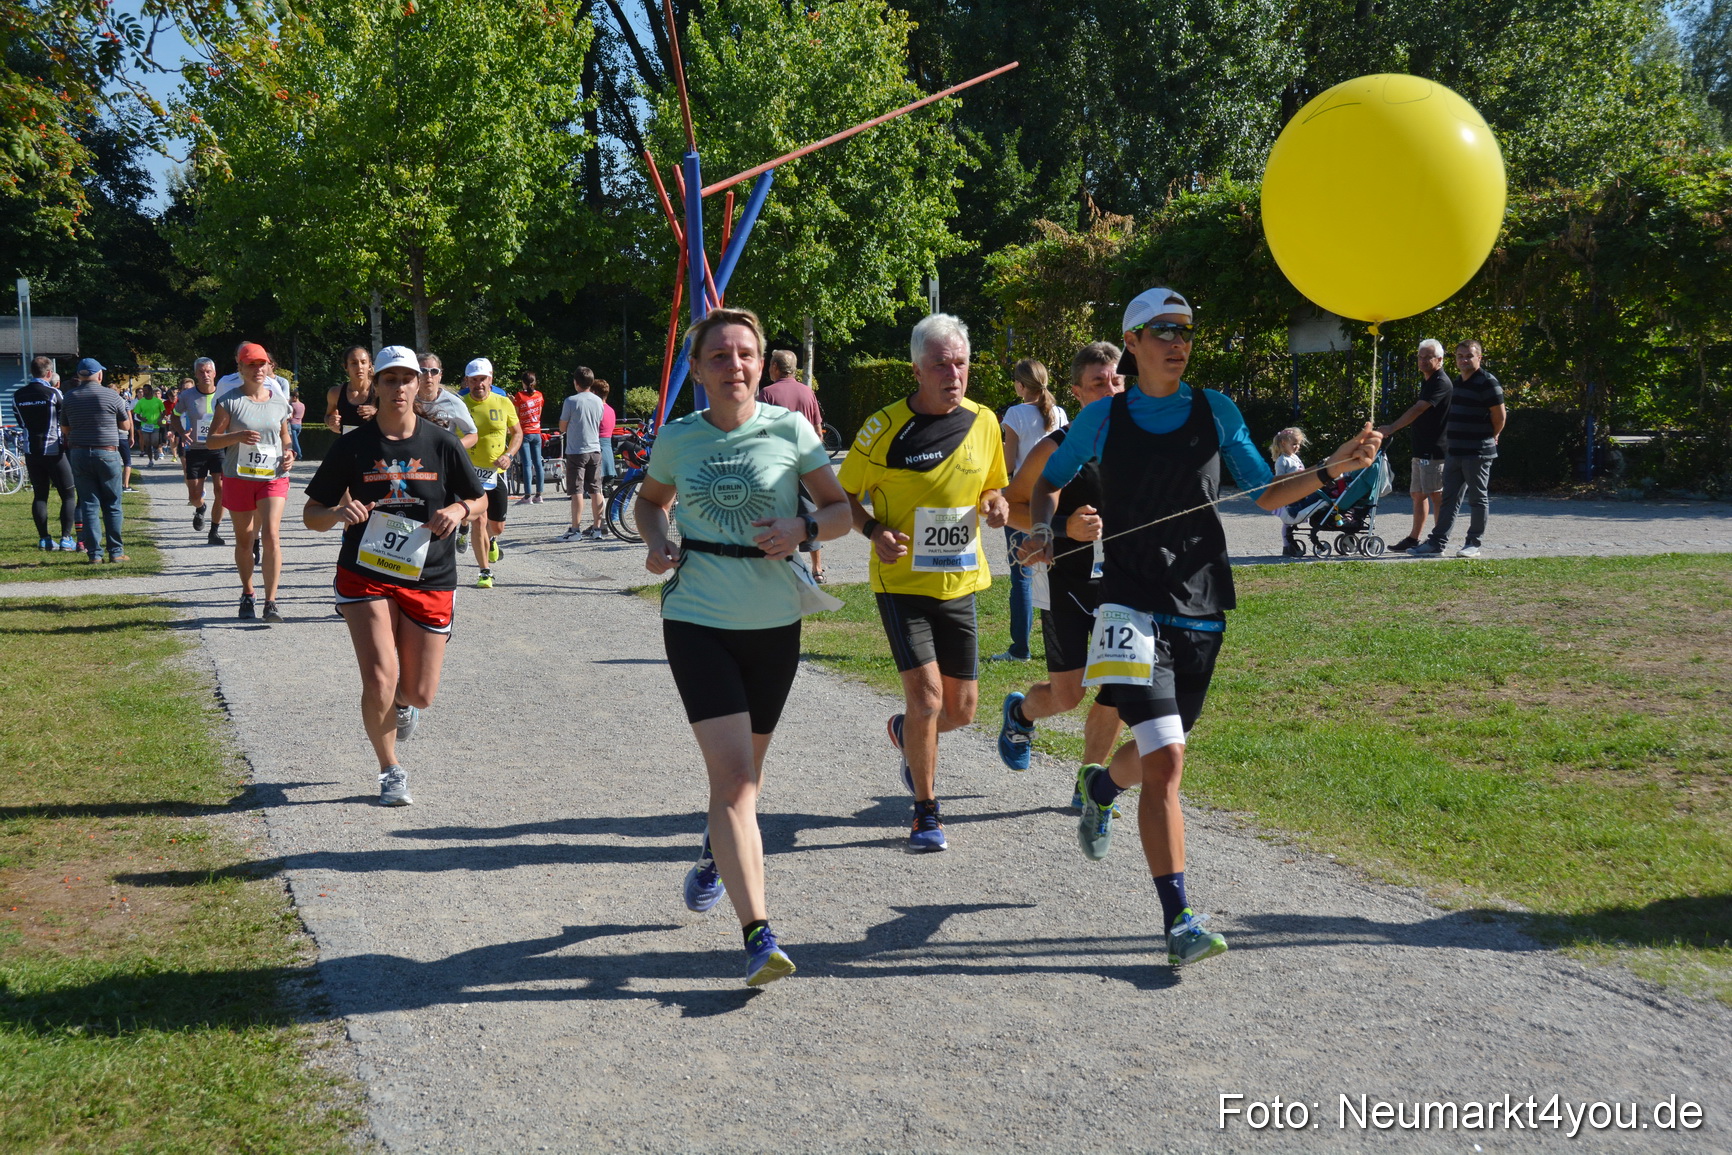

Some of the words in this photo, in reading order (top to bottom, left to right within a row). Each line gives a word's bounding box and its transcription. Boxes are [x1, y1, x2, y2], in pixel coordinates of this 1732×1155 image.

[899, 421, 916, 441] STANNO
[248, 452, 268, 464] 157
[905, 450, 943, 465] Norbert
[365, 473, 388, 481] SOUND
[400, 472, 436, 480] NARROWS
[383, 531, 409, 552] 97
[924, 525, 969, 546] 2063
[376, 558, 402, 571] Moore
[932, 557, 962, 565] Norbert
[1102, 611, 1130, 621] OCK
